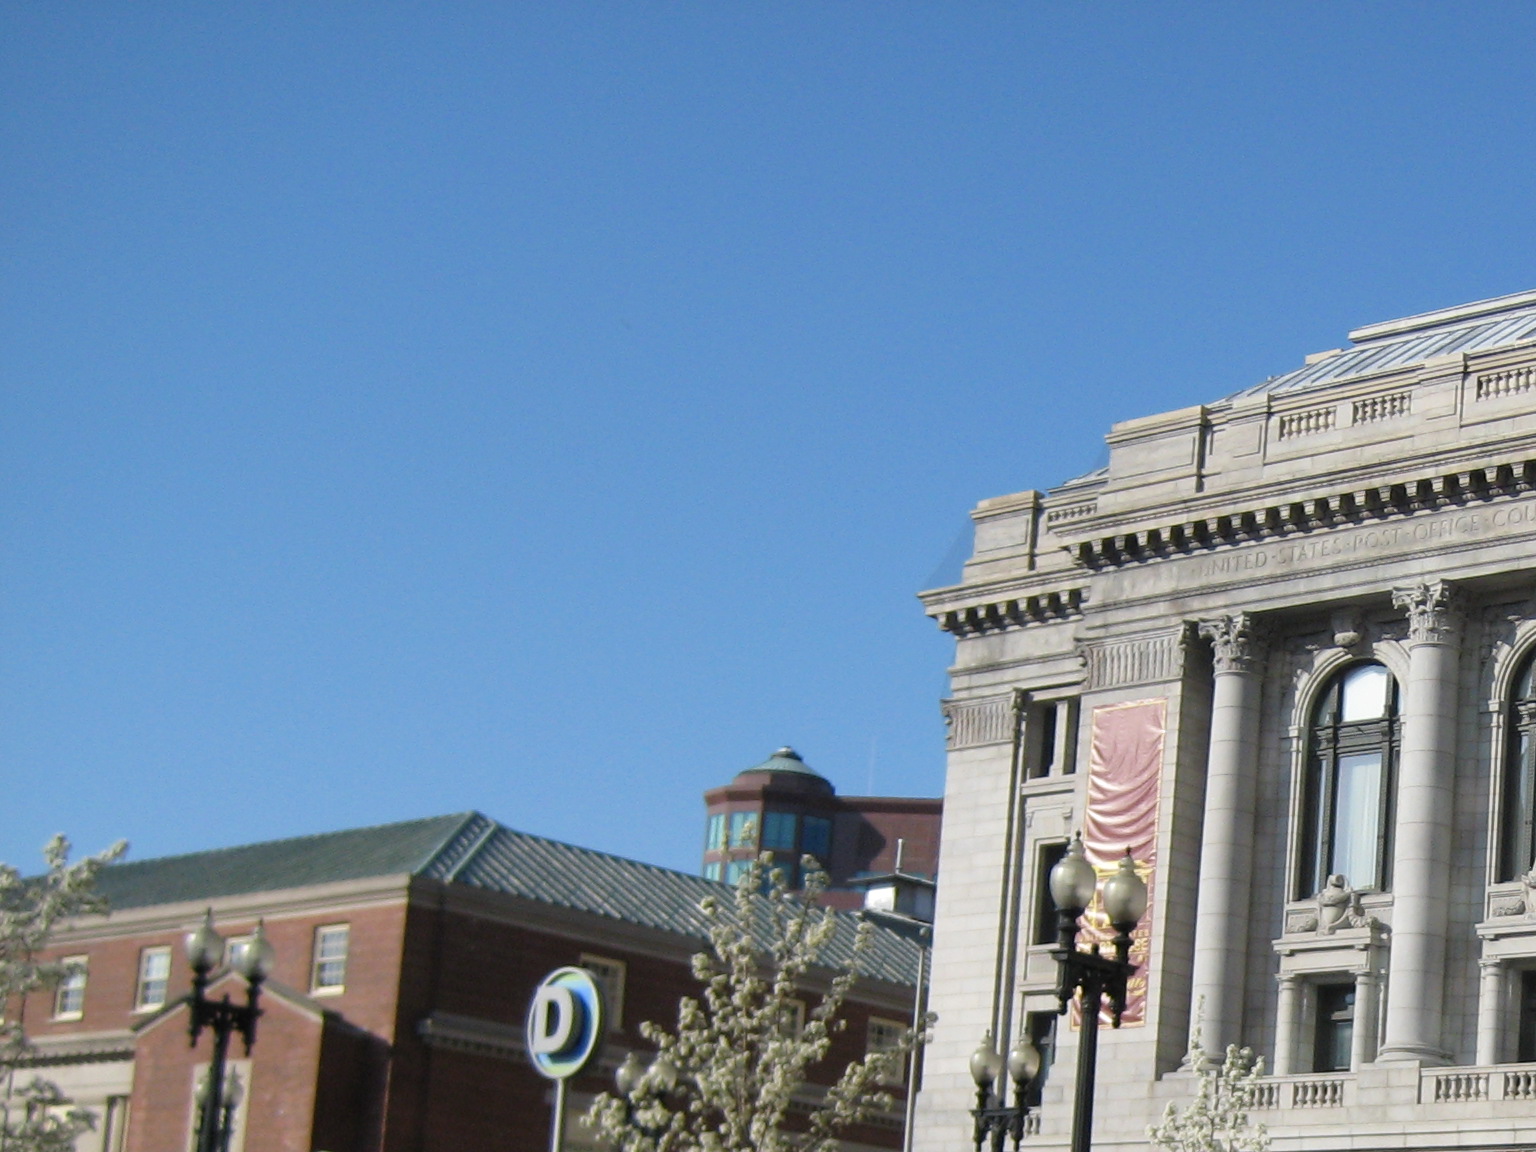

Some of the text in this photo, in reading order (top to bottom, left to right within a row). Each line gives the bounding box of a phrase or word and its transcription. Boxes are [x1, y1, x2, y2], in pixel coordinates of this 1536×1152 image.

[1201, 551, 1267, 577] UNITED
[1276, 539, 1342, 565] STATES
[1352, 527, 1400, 552] POST
[1412, 513, 1478, 541] OFFICE
[532, 985, 574, 1055] D
